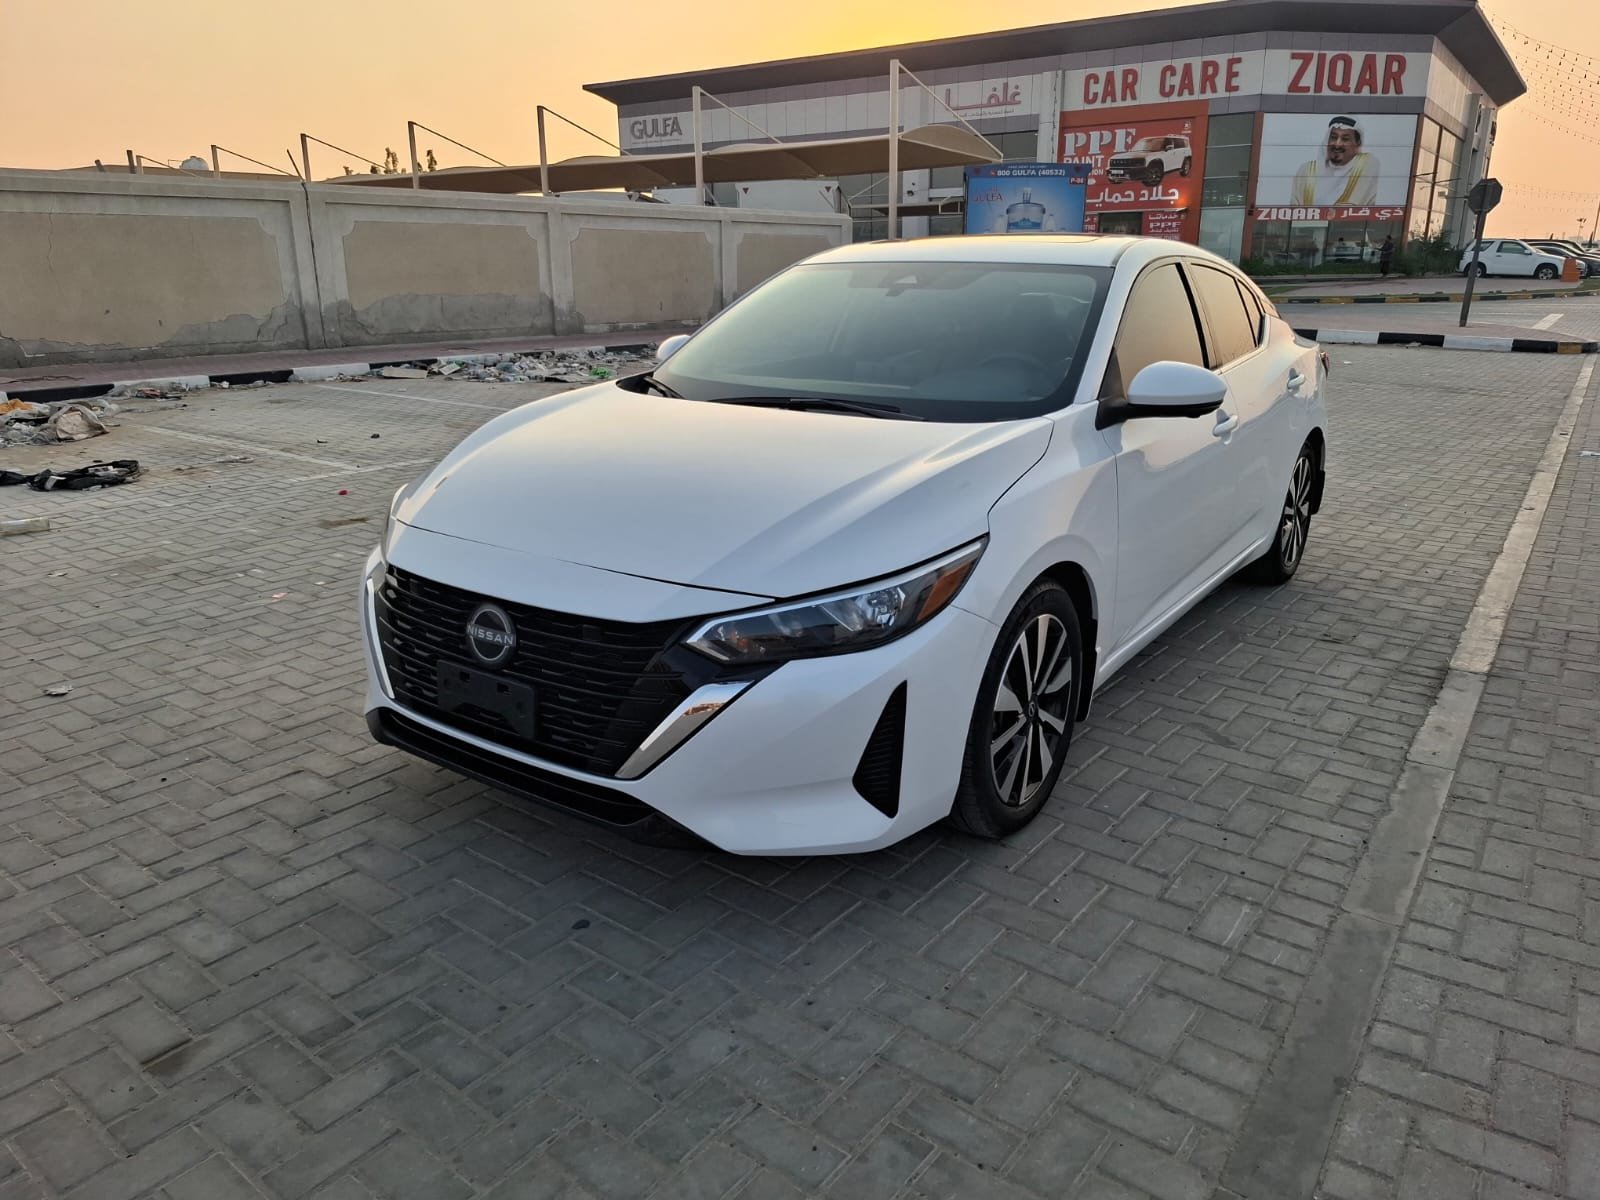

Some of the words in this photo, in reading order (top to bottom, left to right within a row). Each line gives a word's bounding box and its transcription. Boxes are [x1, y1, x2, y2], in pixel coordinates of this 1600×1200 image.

[1083, 68, 1139, 105] CAR
[1159, 57, 1243, 98] CARE
[1287, 52, 1407, 95] ZIQAR
[944, 81, 1022, 111] غلفا
[630, 116, 683, 140] GULFA
[1063, 128, 1137, 156] PPF
[1012, 169, 1036, 177] GULFA
[1086, 187, 1135, 208] حماي
[1257, 207, 1321, 221] ZIQAR
[1340, 207, 1367, 218] قار
[1375, 207, 1404, 220] ذي
[466, 623, 514, 646] NISSAN
